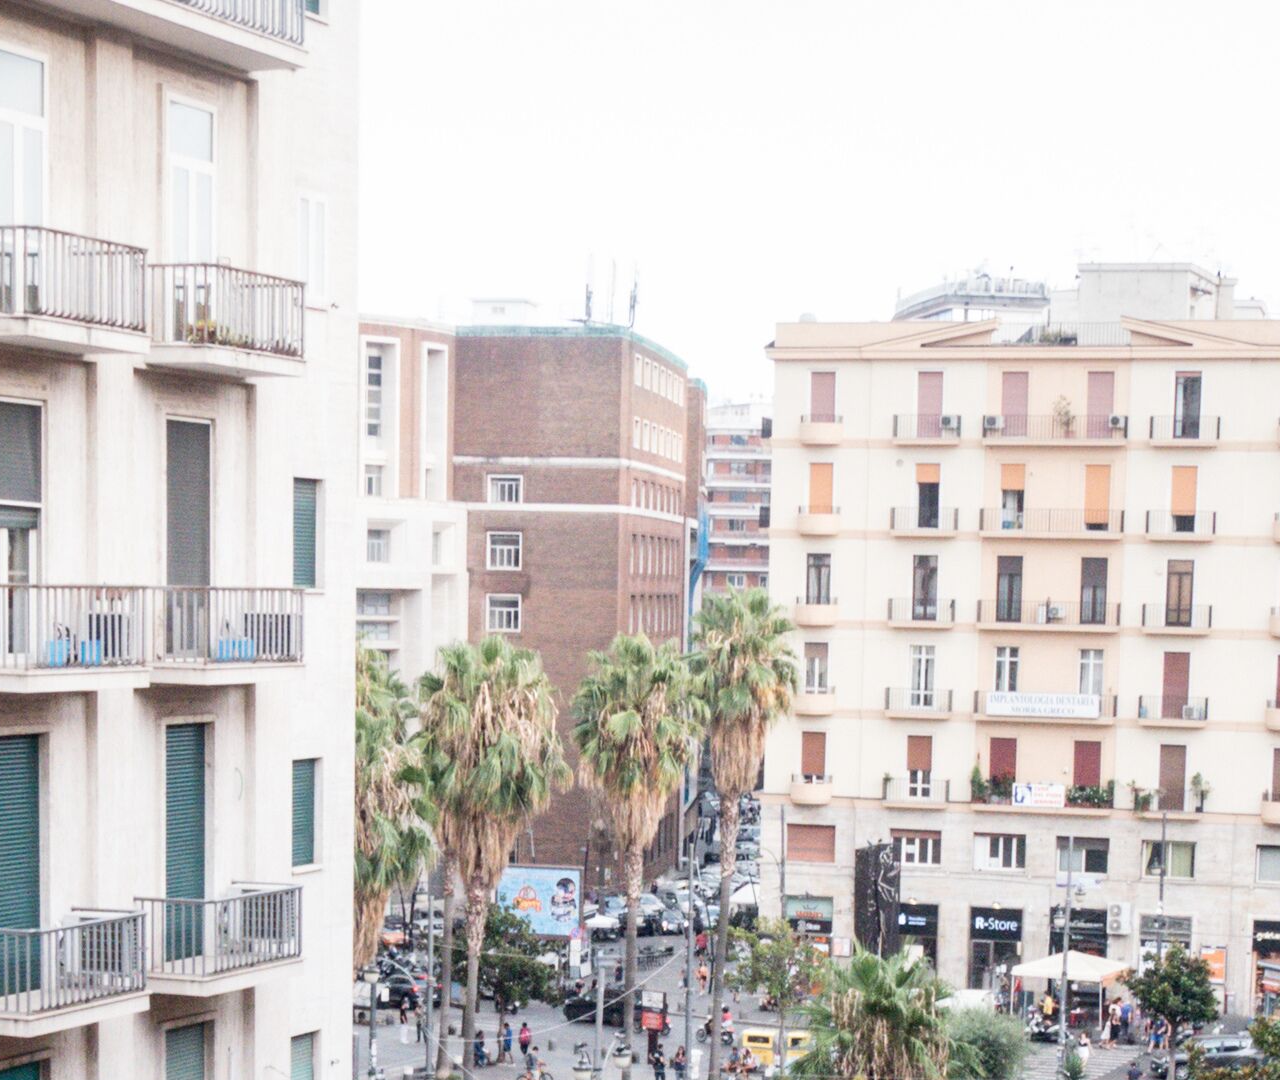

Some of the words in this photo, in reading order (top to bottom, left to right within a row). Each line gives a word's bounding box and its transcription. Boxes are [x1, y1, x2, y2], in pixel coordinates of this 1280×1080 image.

[990, 694, 1053, 705] IMPLANTOLOGIA
[1056, 696, 1095, 706] DENTARIA
[1011, 706, 1042, 714] MORRA
[975, 916, 1018, 931] R-Store
